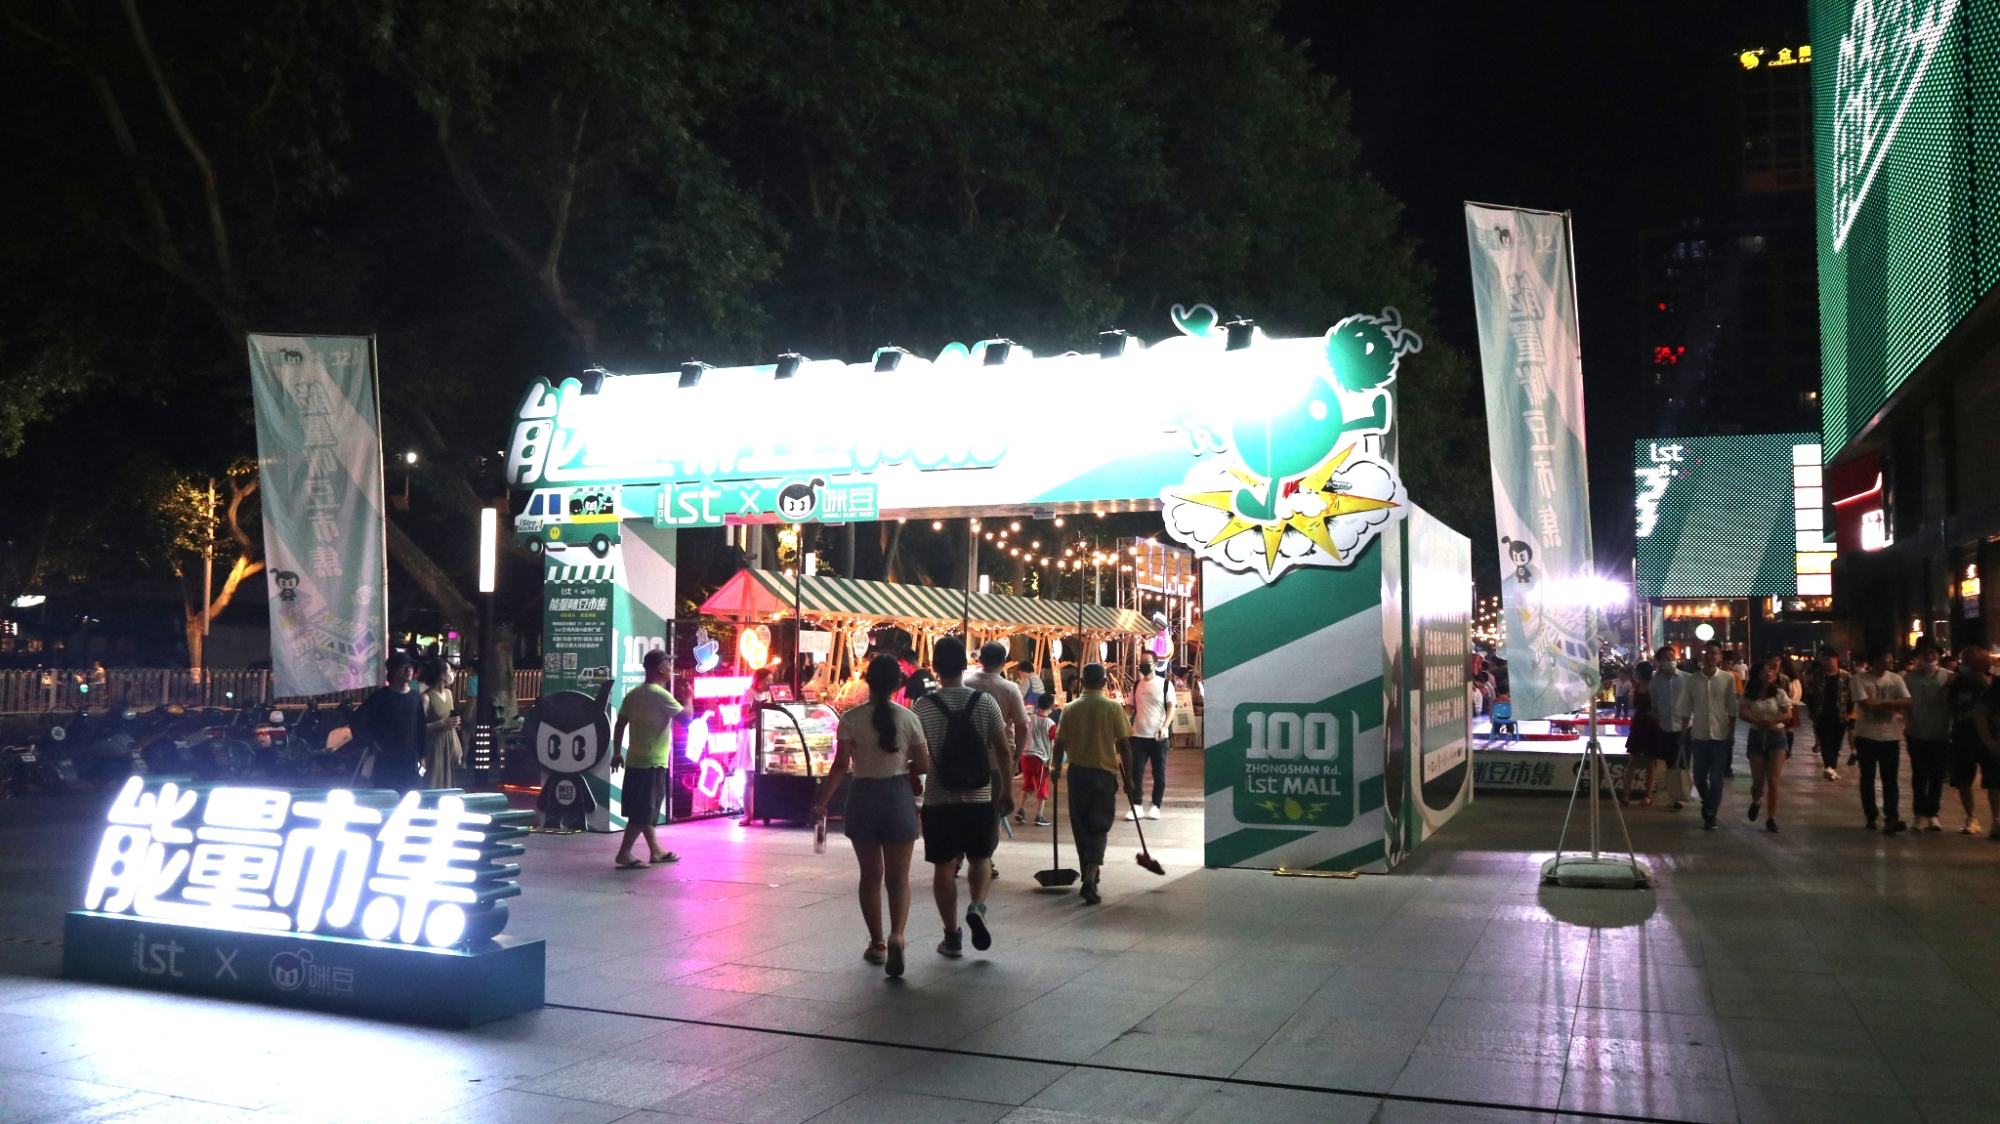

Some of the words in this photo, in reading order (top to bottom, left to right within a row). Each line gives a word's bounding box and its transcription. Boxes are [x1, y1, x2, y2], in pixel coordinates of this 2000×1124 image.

[664, 483, 720, 523] ist
[822, 488, 874, 512] 咪豆
[549, 597, 608, 611] 能量咪豆市集
[1246, 711, 1339, 761] 100
[1245, 764, 1320, 775] ZHONGSHAN
[1323, 765, 1341, 776] Rd.
[1247, 775, 1278, 793] ist
[1283, 777, 1341, 795] MALL
[84, 775, 492, 948] 能量市集
[137, 933, 185, 978] ist
[308, 964, 354, 992] 咪豆
